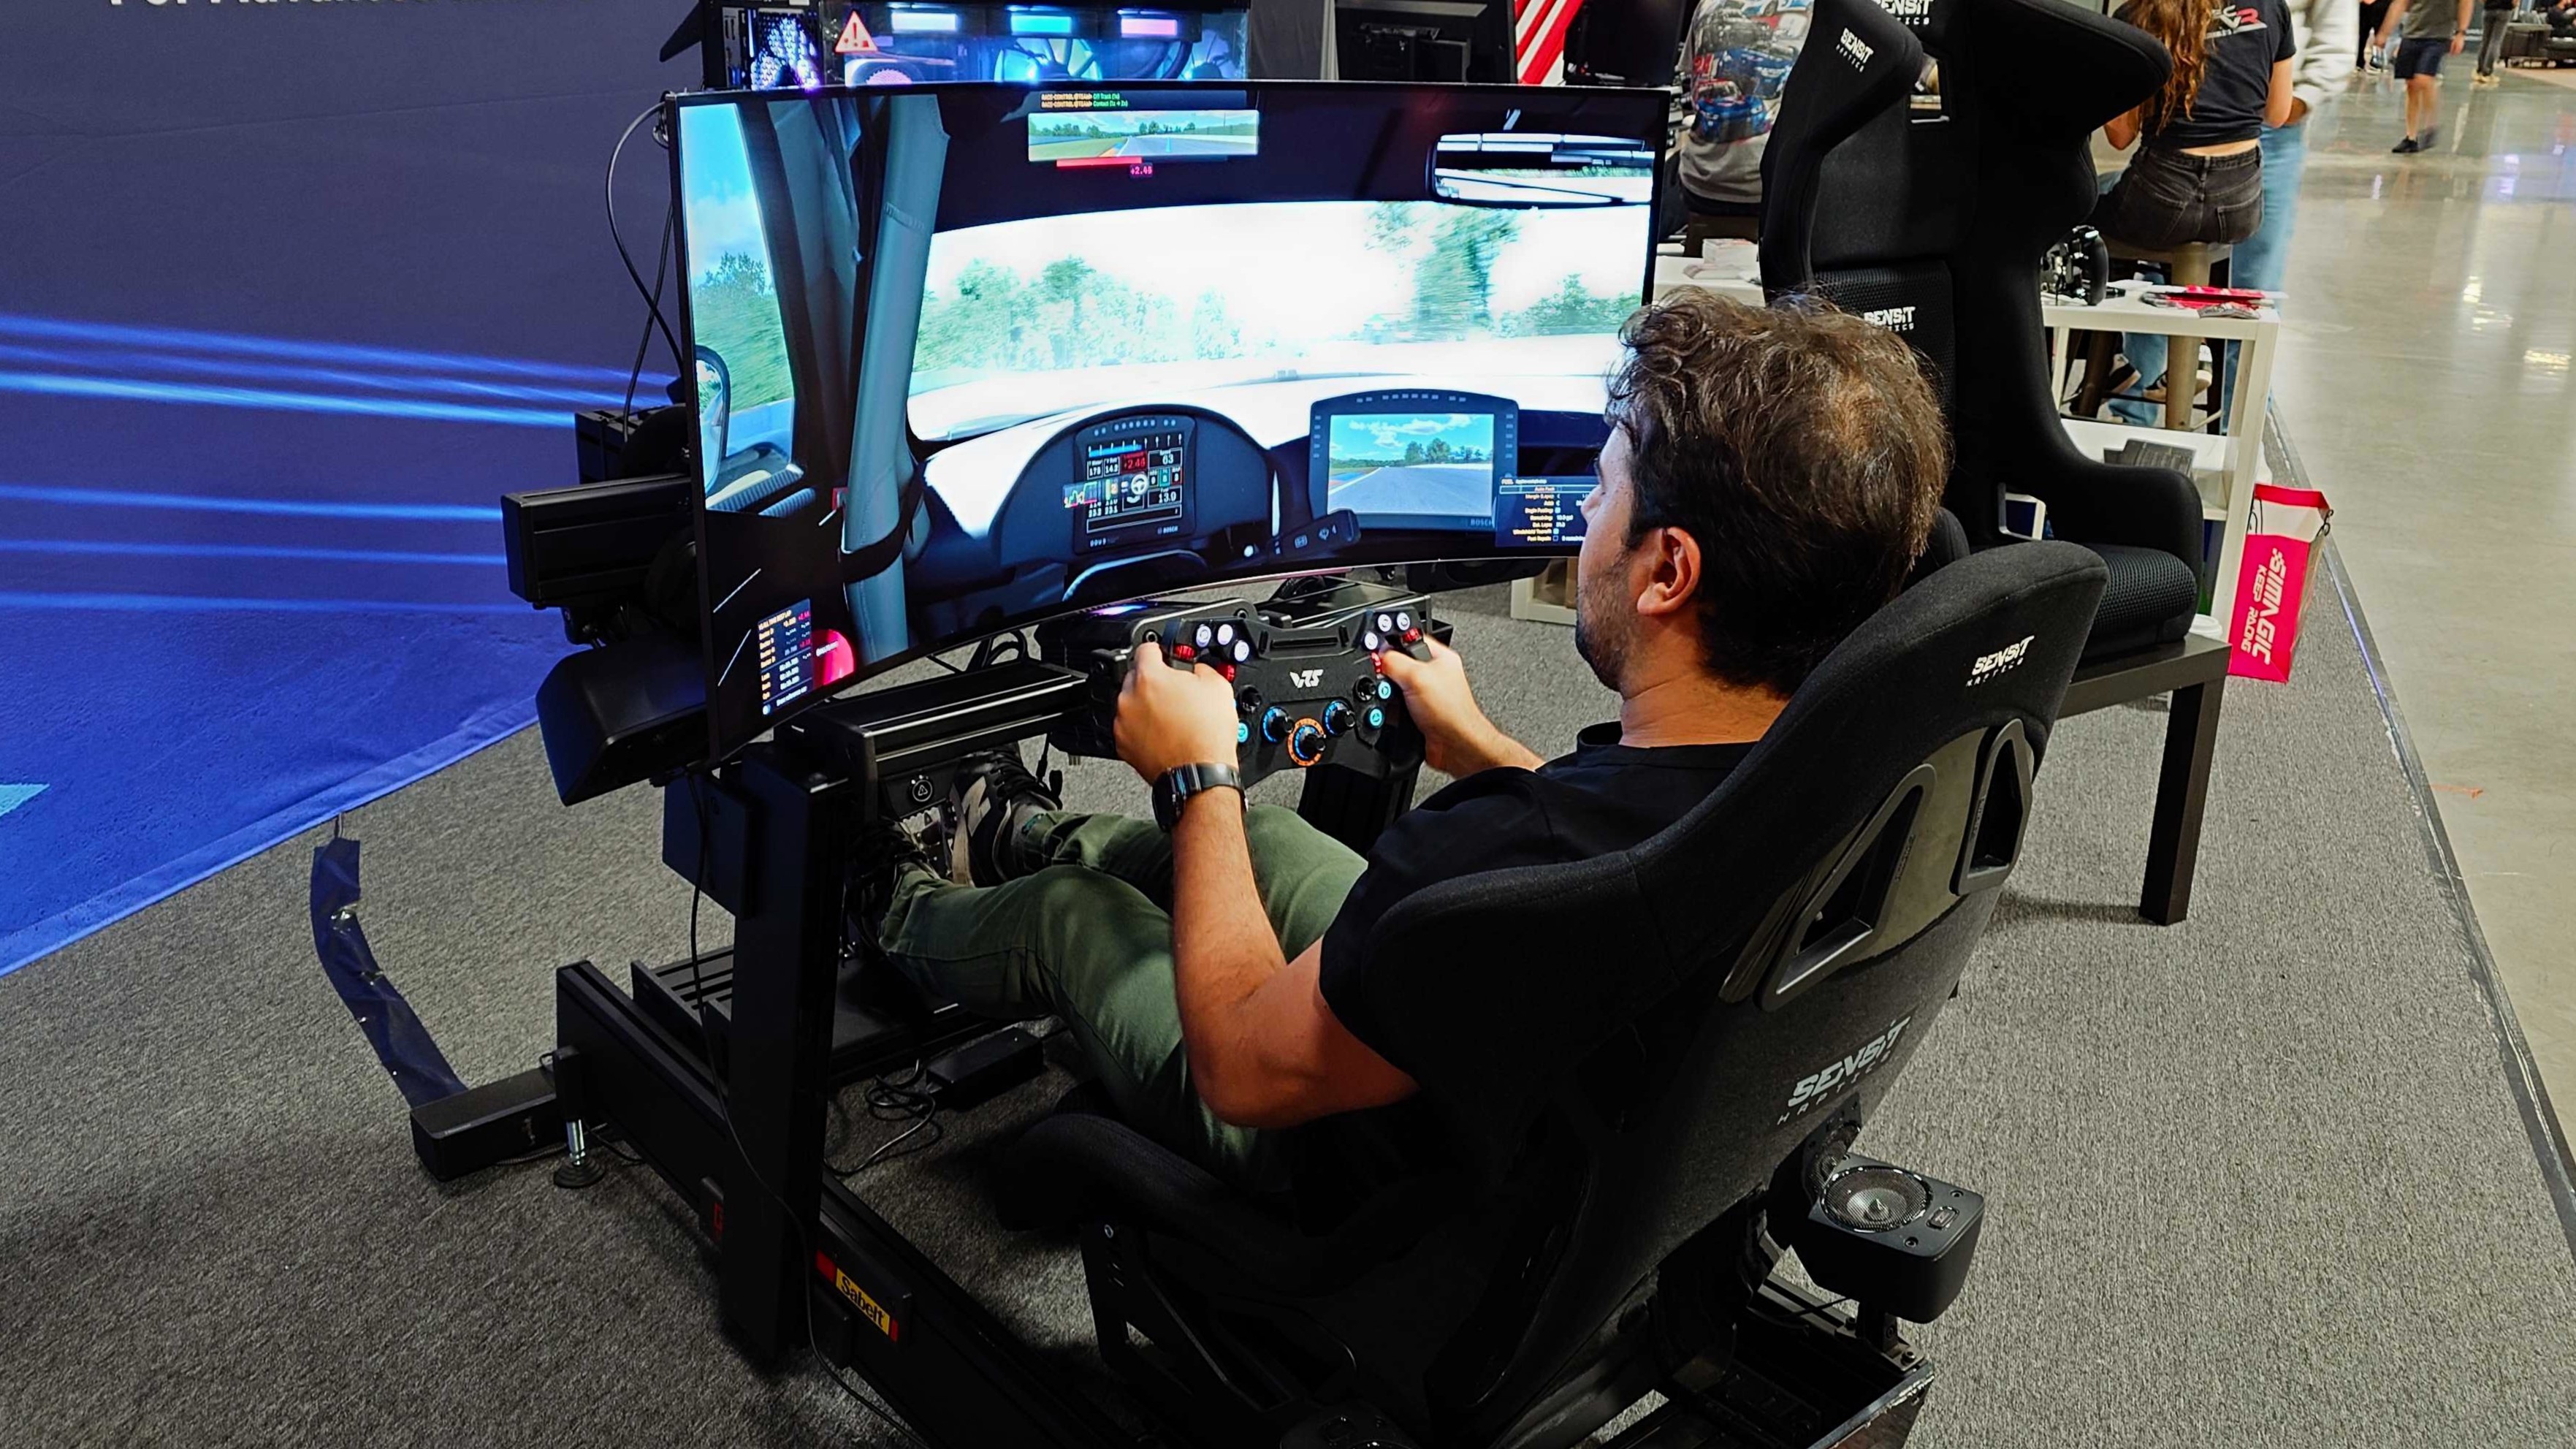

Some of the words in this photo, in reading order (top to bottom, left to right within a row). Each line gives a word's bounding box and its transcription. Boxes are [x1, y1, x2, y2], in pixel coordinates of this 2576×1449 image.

[2252, 564, 2268, 603] KEEP
[2241, 606, 2258, 653] RACING
[1971, 635, 2035, 676] SENSIT
[1289, 669, 1324, 688] VRS
[1788, 1016, 1911, 1107] SENSIT
[841, 1275, 885, 1328] Sabelt
